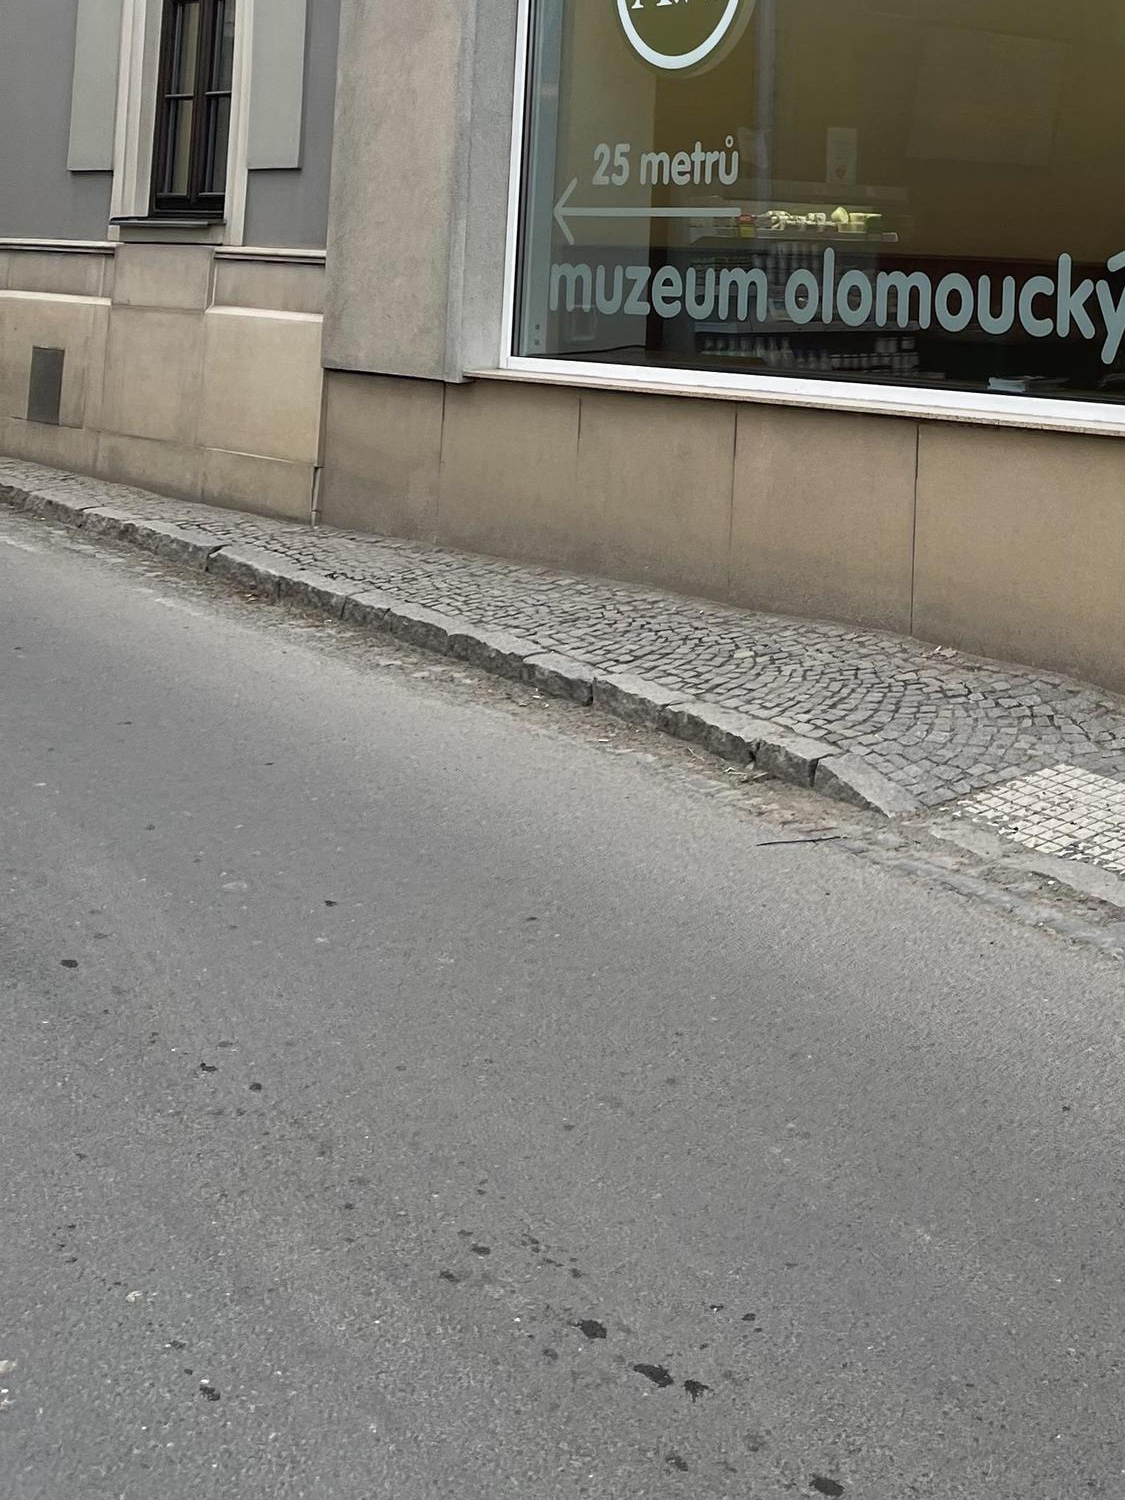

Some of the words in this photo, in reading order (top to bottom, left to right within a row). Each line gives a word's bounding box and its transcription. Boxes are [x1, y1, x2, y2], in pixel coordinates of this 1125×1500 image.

[592, 143, 631, 186] 25
[640, 135, 739, 186] metrů
[549, 262, 768, 321] muzeum
